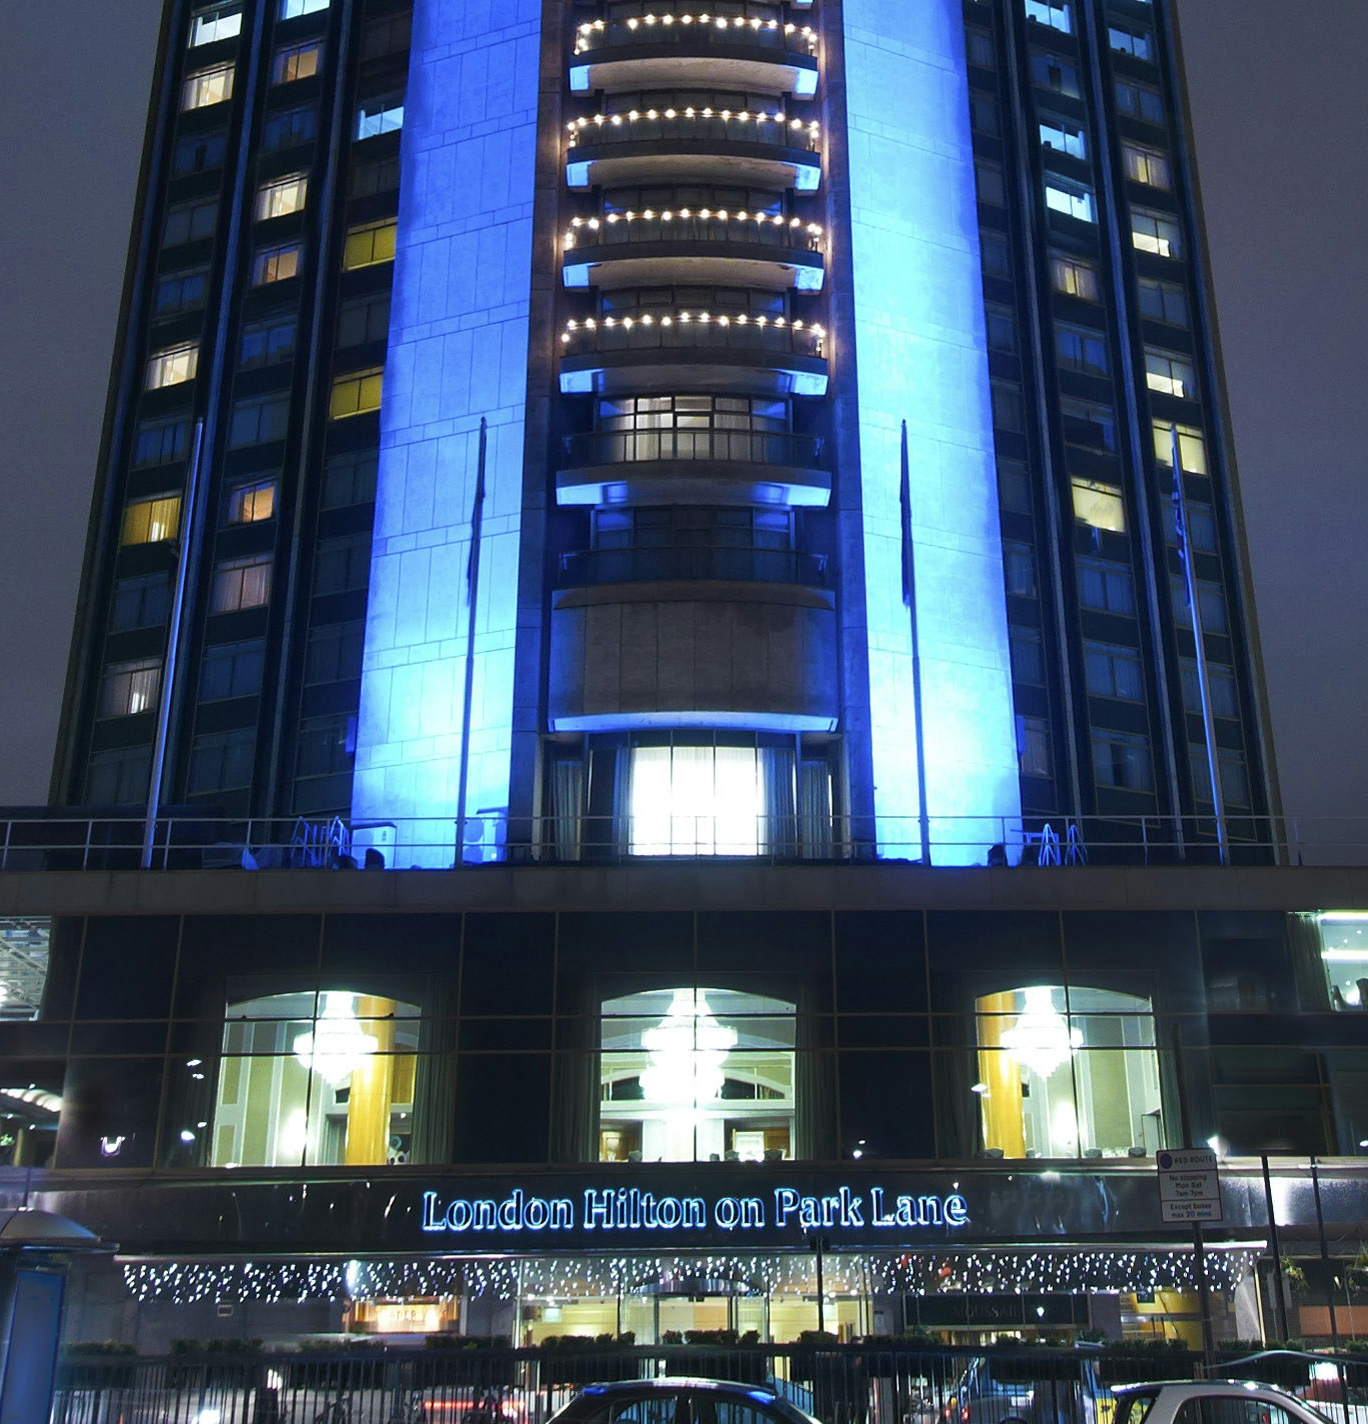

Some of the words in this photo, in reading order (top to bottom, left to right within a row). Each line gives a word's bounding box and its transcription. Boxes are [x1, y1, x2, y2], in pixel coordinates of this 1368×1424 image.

[423, 1189, 574, 1230] London
[583, 1187, 705, 1229] Hilton
[715, 1196, 765, 1228] on
[774, 1186, 863, 1228] Park
[871, 1187, 968, 1227] Lane
